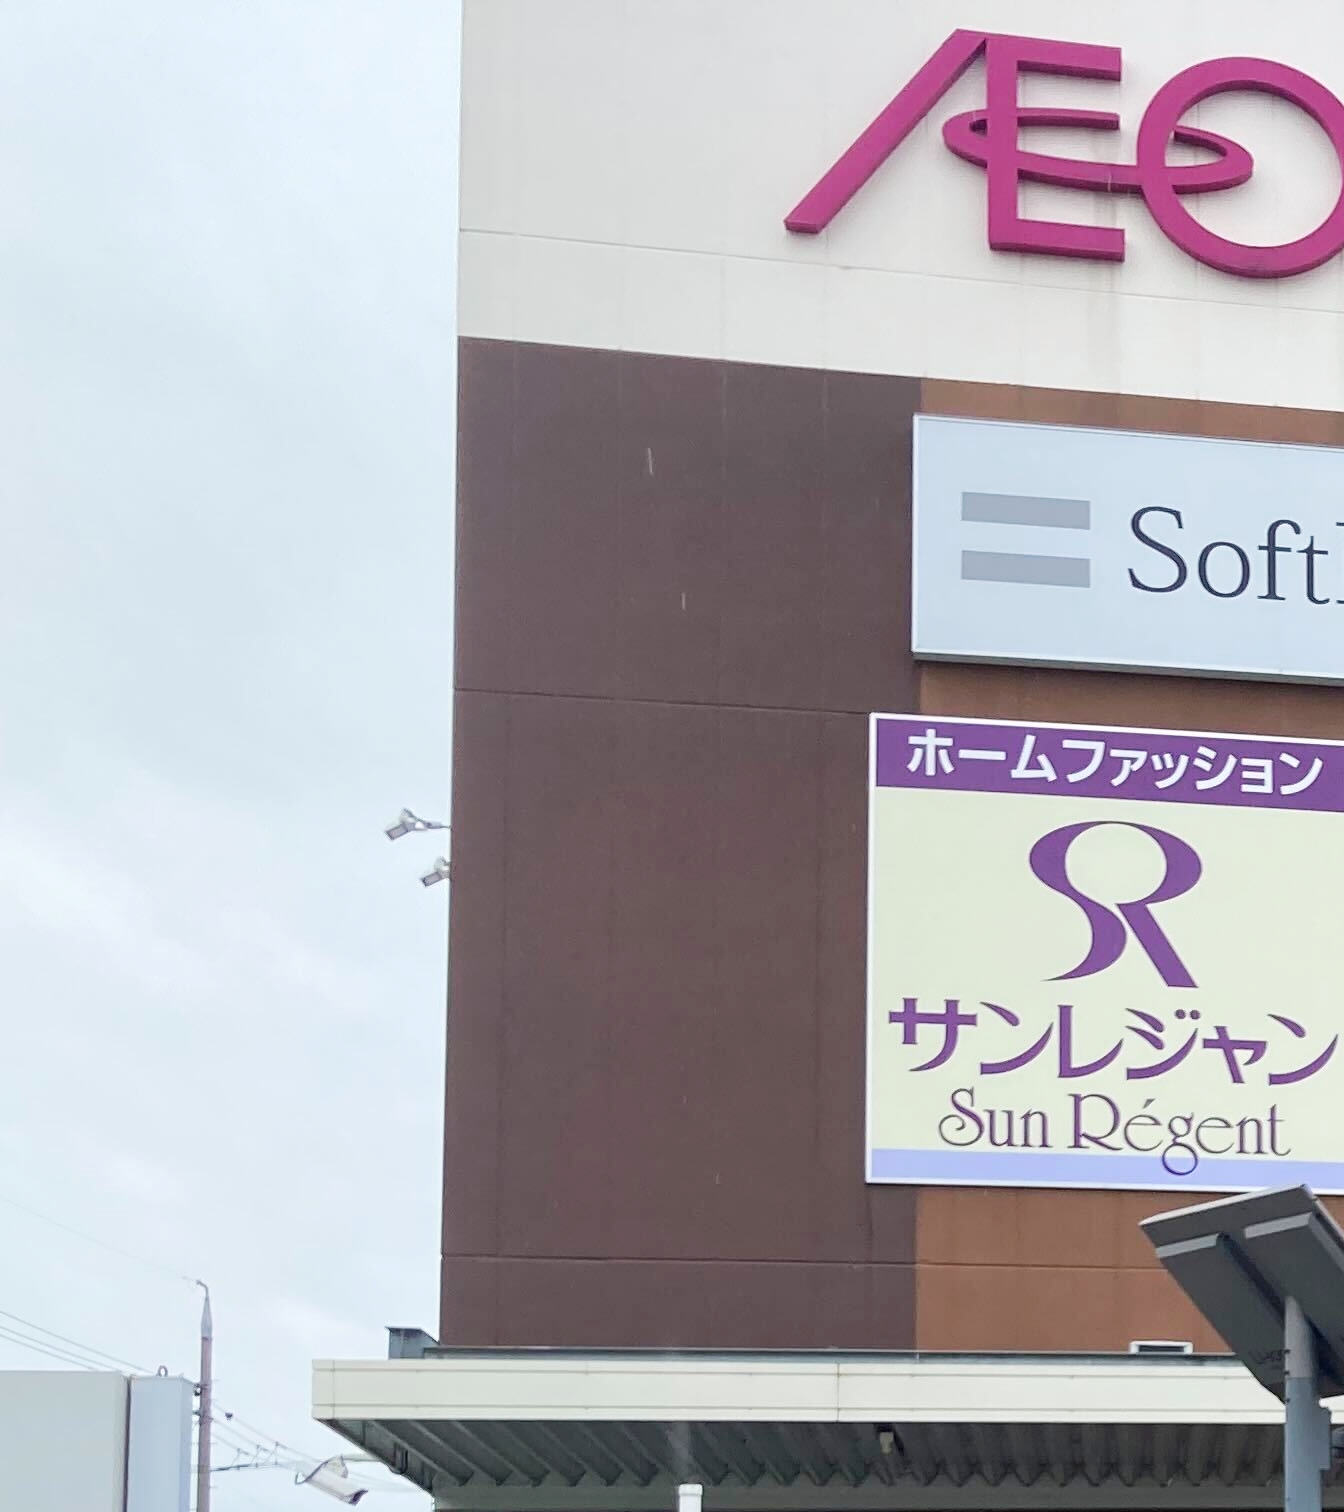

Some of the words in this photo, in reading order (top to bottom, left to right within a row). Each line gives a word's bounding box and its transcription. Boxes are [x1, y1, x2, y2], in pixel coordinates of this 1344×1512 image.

[906, 728, 1324, 796] ホームファッション
[888, 997, 1339, 1086] サンレジャン
[938, 1086, 1053, 1150] Sun
[1067, 1092, 1291, 1176] Régent
